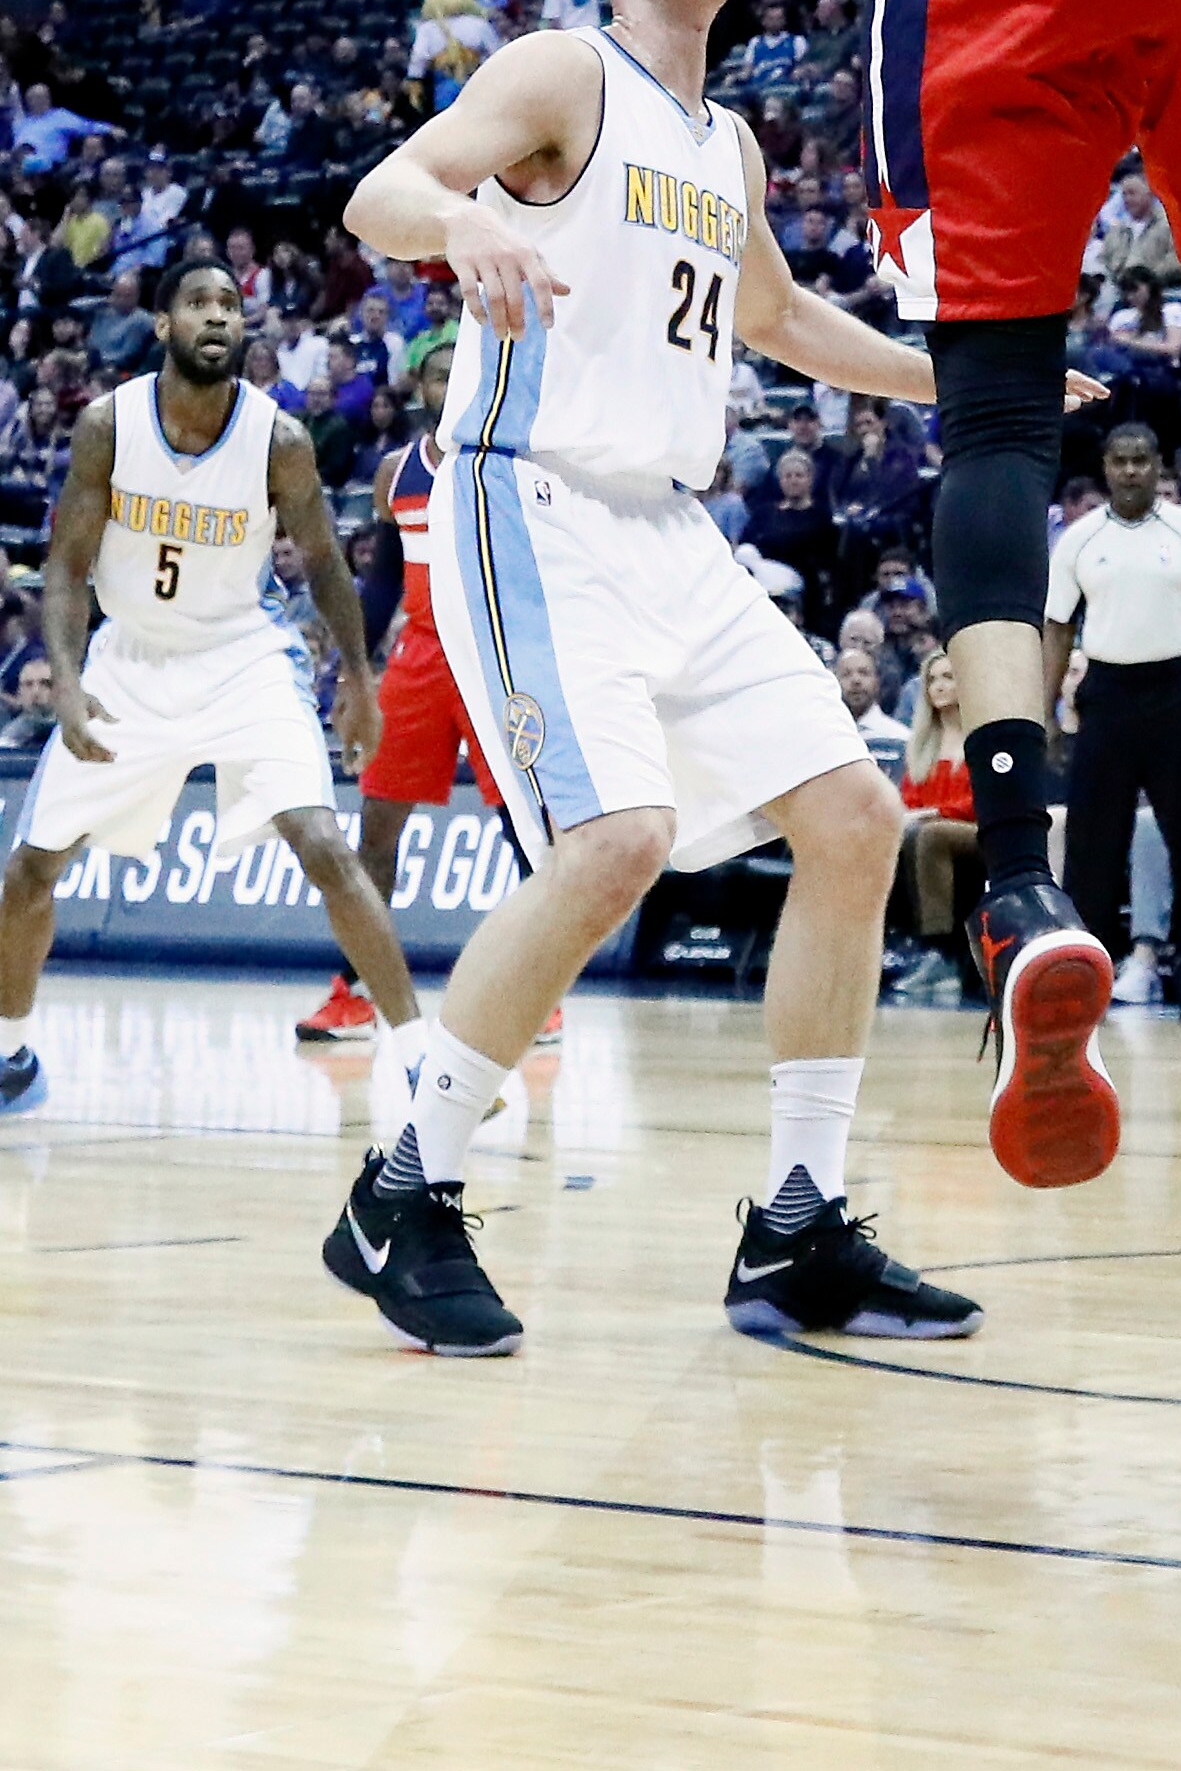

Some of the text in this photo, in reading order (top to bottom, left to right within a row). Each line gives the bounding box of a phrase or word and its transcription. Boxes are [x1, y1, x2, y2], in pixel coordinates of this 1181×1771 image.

[623, 162, 748, 268] NUGGET
[666, 258, 724, 363] 24
[111, 488, 249, 546] NUGGETS
[154, 543, 184, 601] 5
